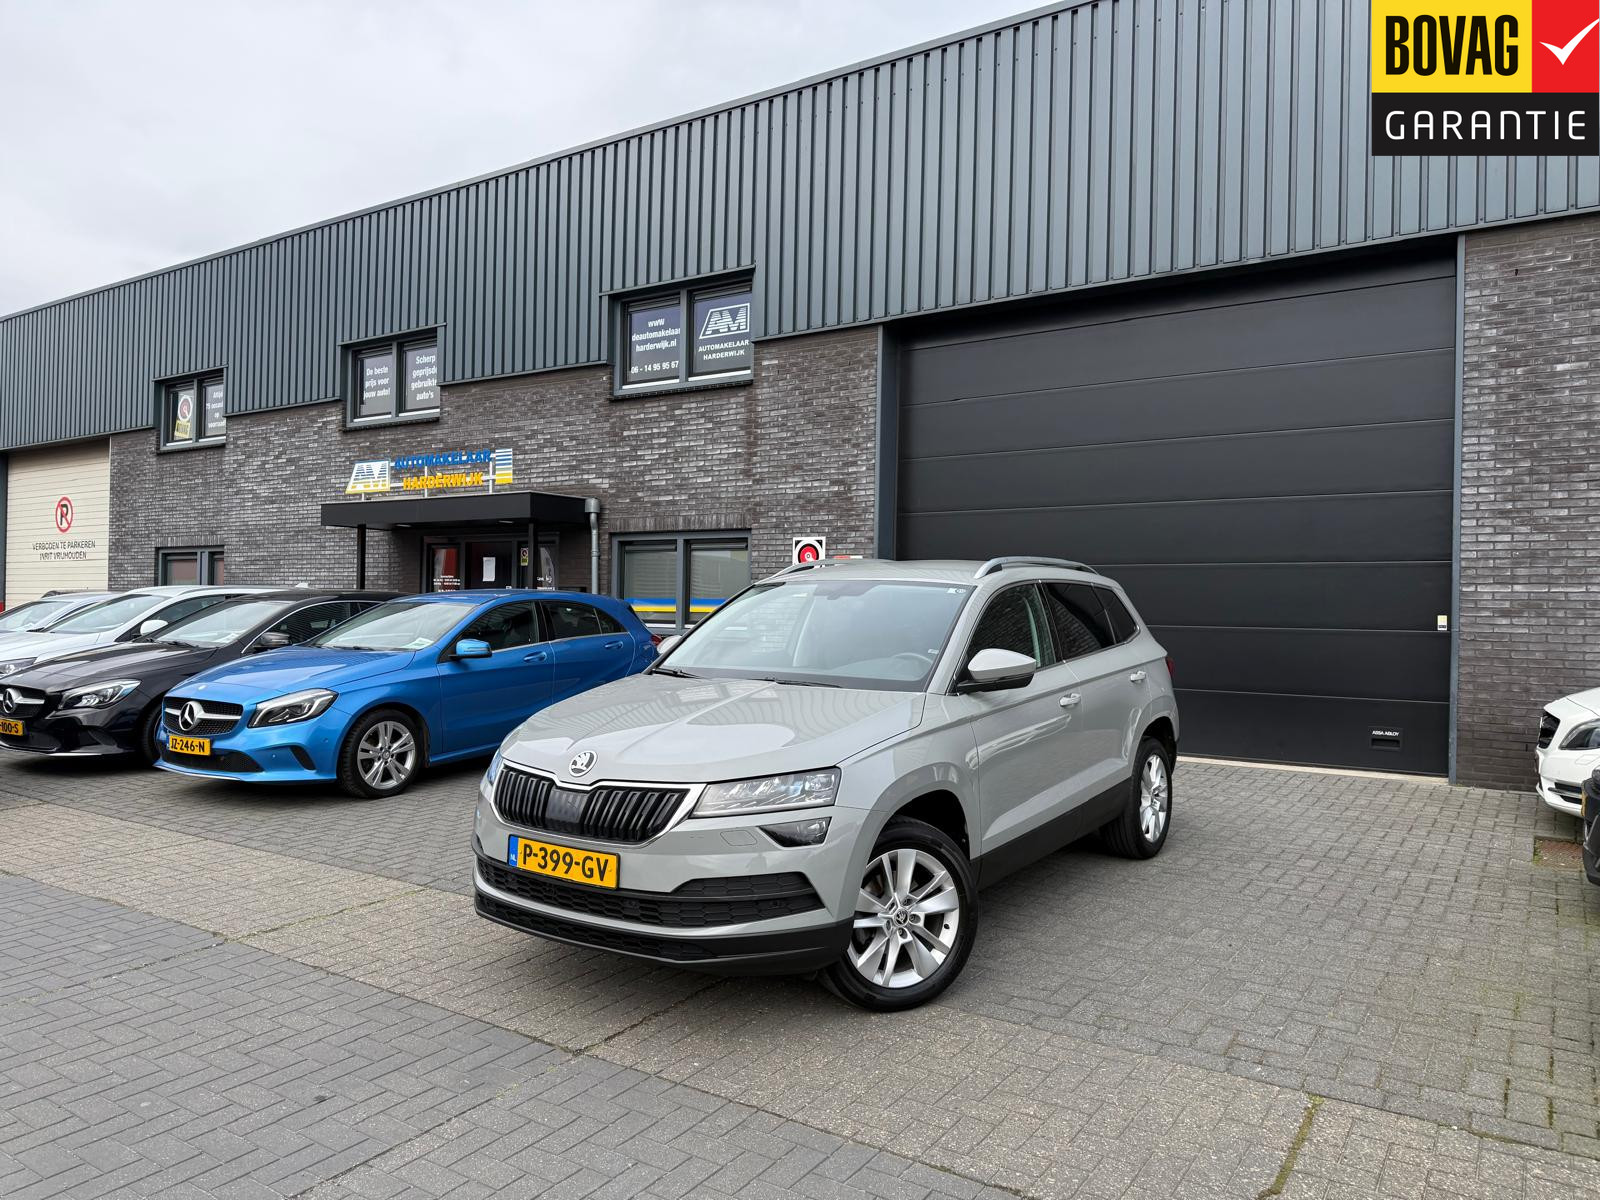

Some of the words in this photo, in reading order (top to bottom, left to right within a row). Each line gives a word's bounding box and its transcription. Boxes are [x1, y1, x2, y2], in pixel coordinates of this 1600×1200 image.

[635, 339, 677, 353] harderwijk.nl
[698, 339, 749, 352] AUTOMAKELAAR
[415, 354, 436, 365] Scherp
[703, 349, 745, 361] HARDERWIJK
[644, 363, 652, 372] 14
[653, 362, 661, 371] 95
[662, 361, 670, 370] 95
[364, 378, 377, 389] prijs
[377, 377, 390, 386] voor
[416, 390, 434, 401] auto's
[394, 449, 491, 469] AUTOMAKELAAR
[403, 471, 484, 490] HARDERWIJK
[32, 541, 59, 551] VERBODEN
[60, 541, 66, 550] TE
[67, 540, 96, 550] PARKEREN
[171, 737, 205, 753] JZ-246-N
[522, 843, 609, 882] P-399-GV
